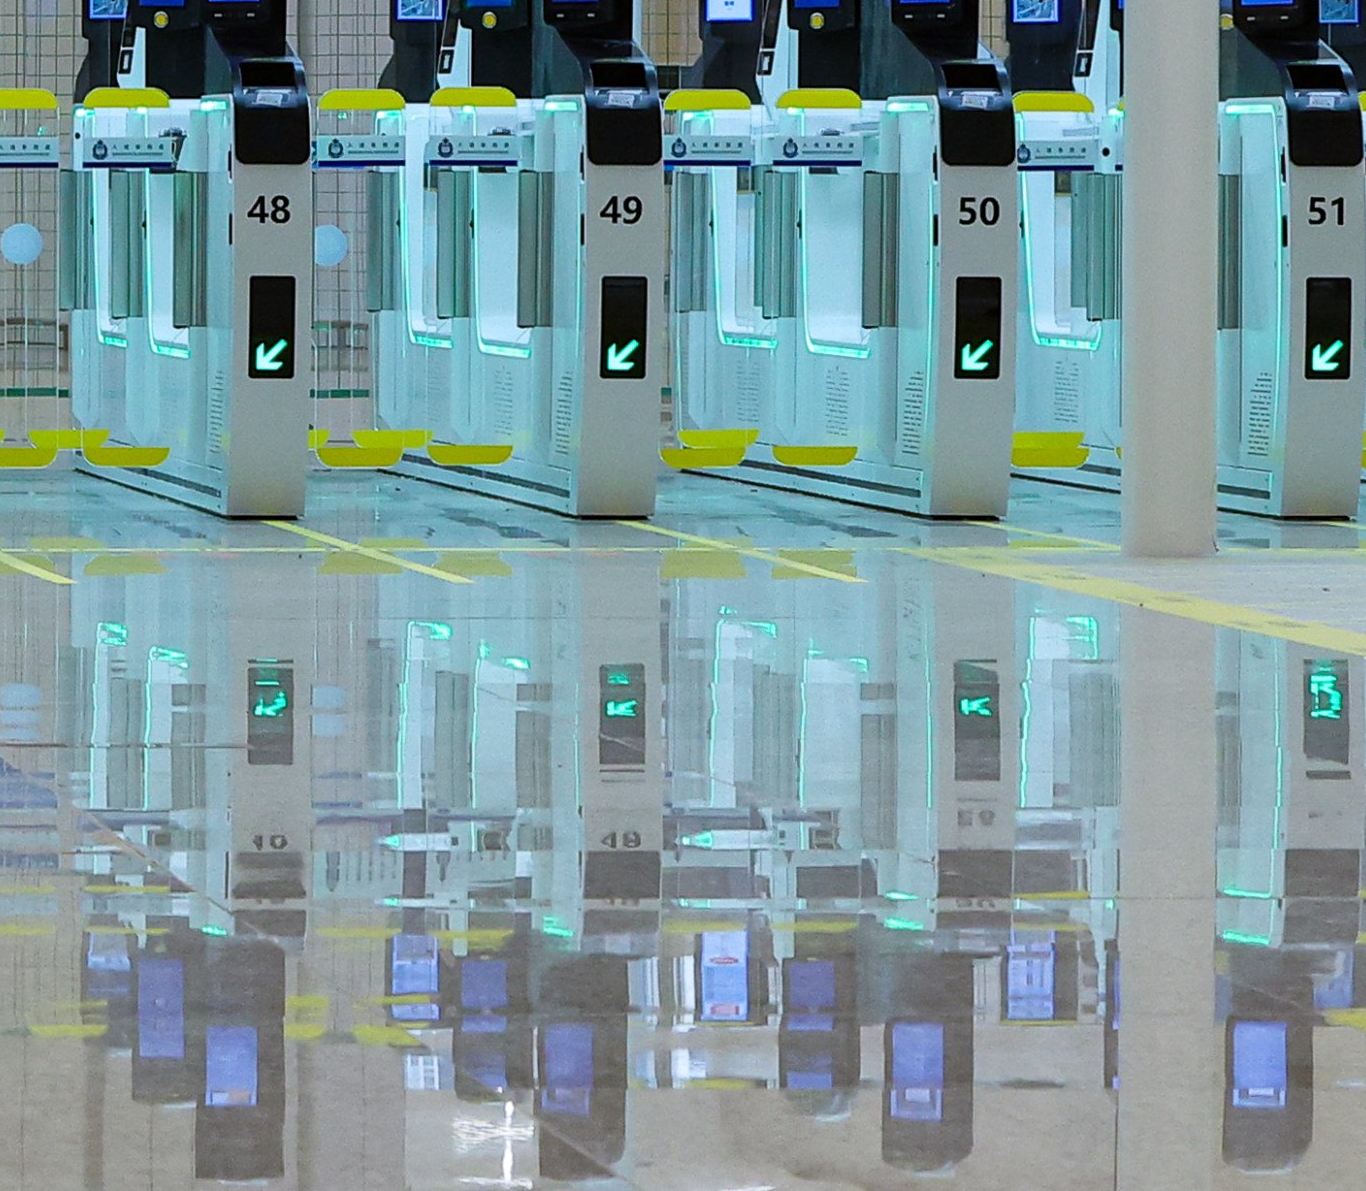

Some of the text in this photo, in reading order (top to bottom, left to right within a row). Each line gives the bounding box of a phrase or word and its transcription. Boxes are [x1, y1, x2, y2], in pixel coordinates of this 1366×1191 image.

[246, 195, 291, 224] 48
[599, 195, 643, 225] 49
[958, 196, 1000, 226] 50
[1308, 196, 1345, 226] 51
